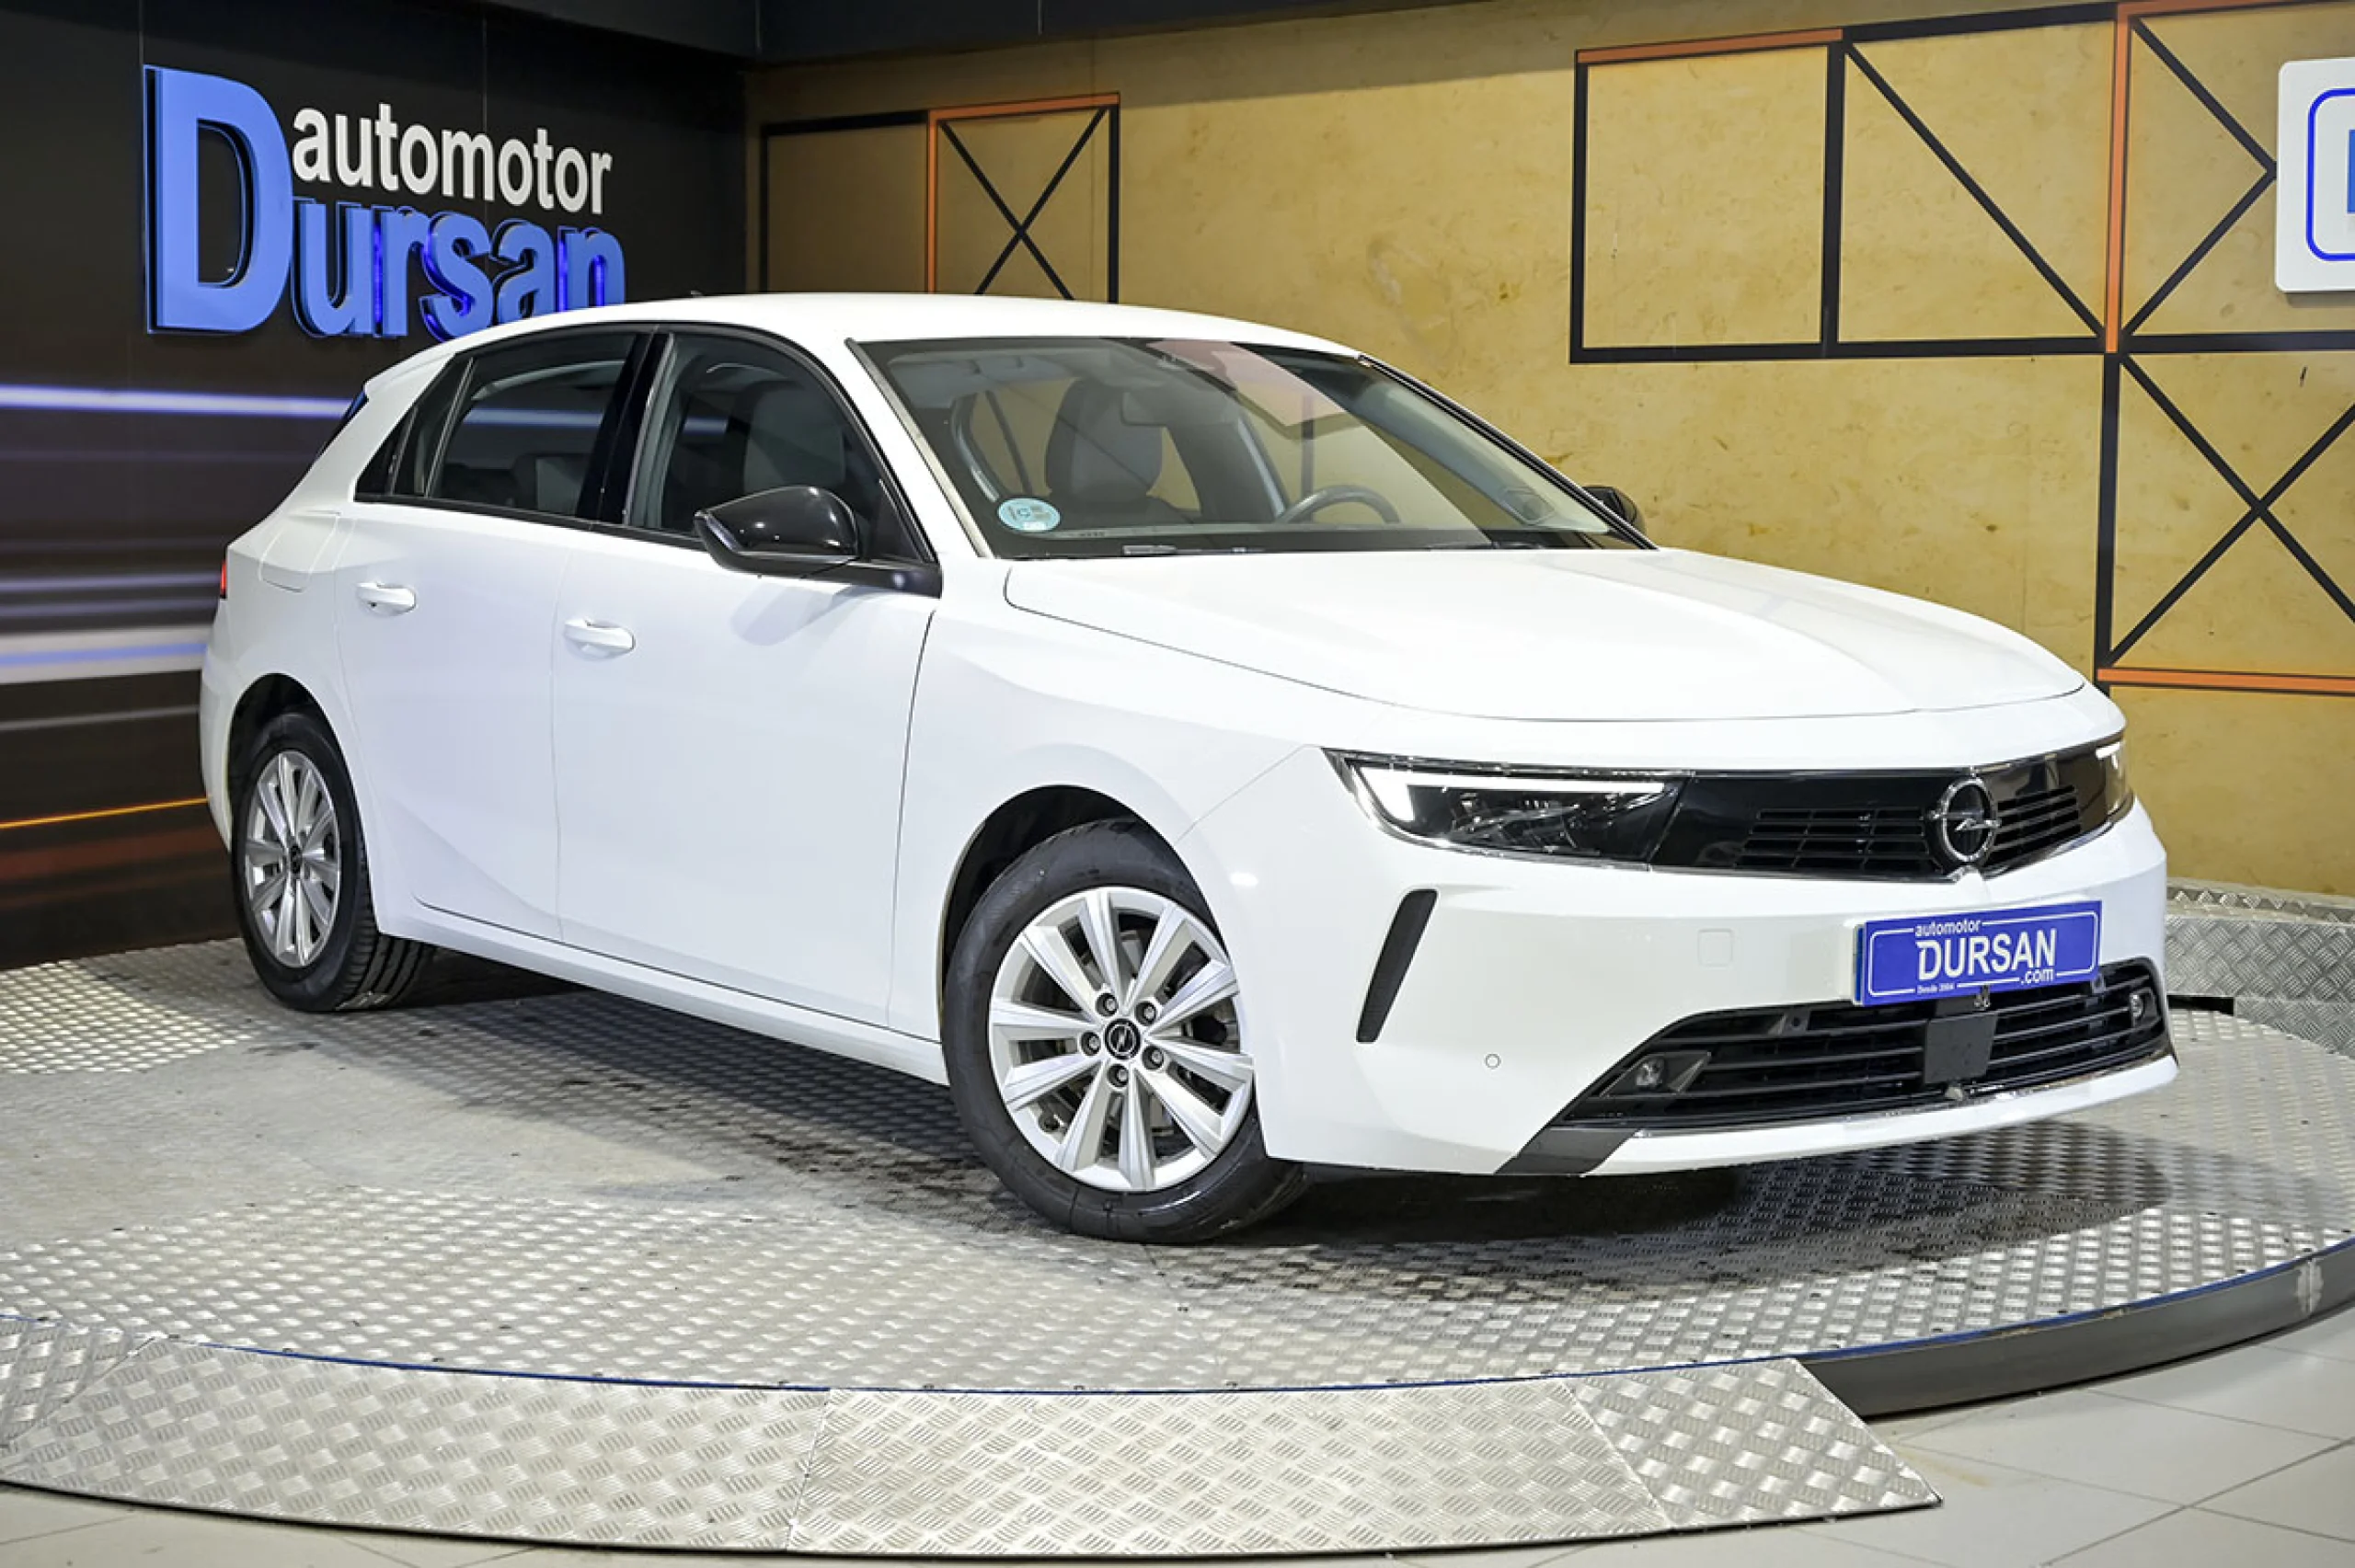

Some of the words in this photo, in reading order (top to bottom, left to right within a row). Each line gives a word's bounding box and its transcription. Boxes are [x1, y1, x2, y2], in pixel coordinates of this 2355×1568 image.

[293, 103, 613, 214] automotor
[144, 64, 626, 341] Dursan
[1914, 919, 1981, 936] automotor
[1916, 928, 2057, 980] DURSAN
[2020, 968, 2054, 984] .com
